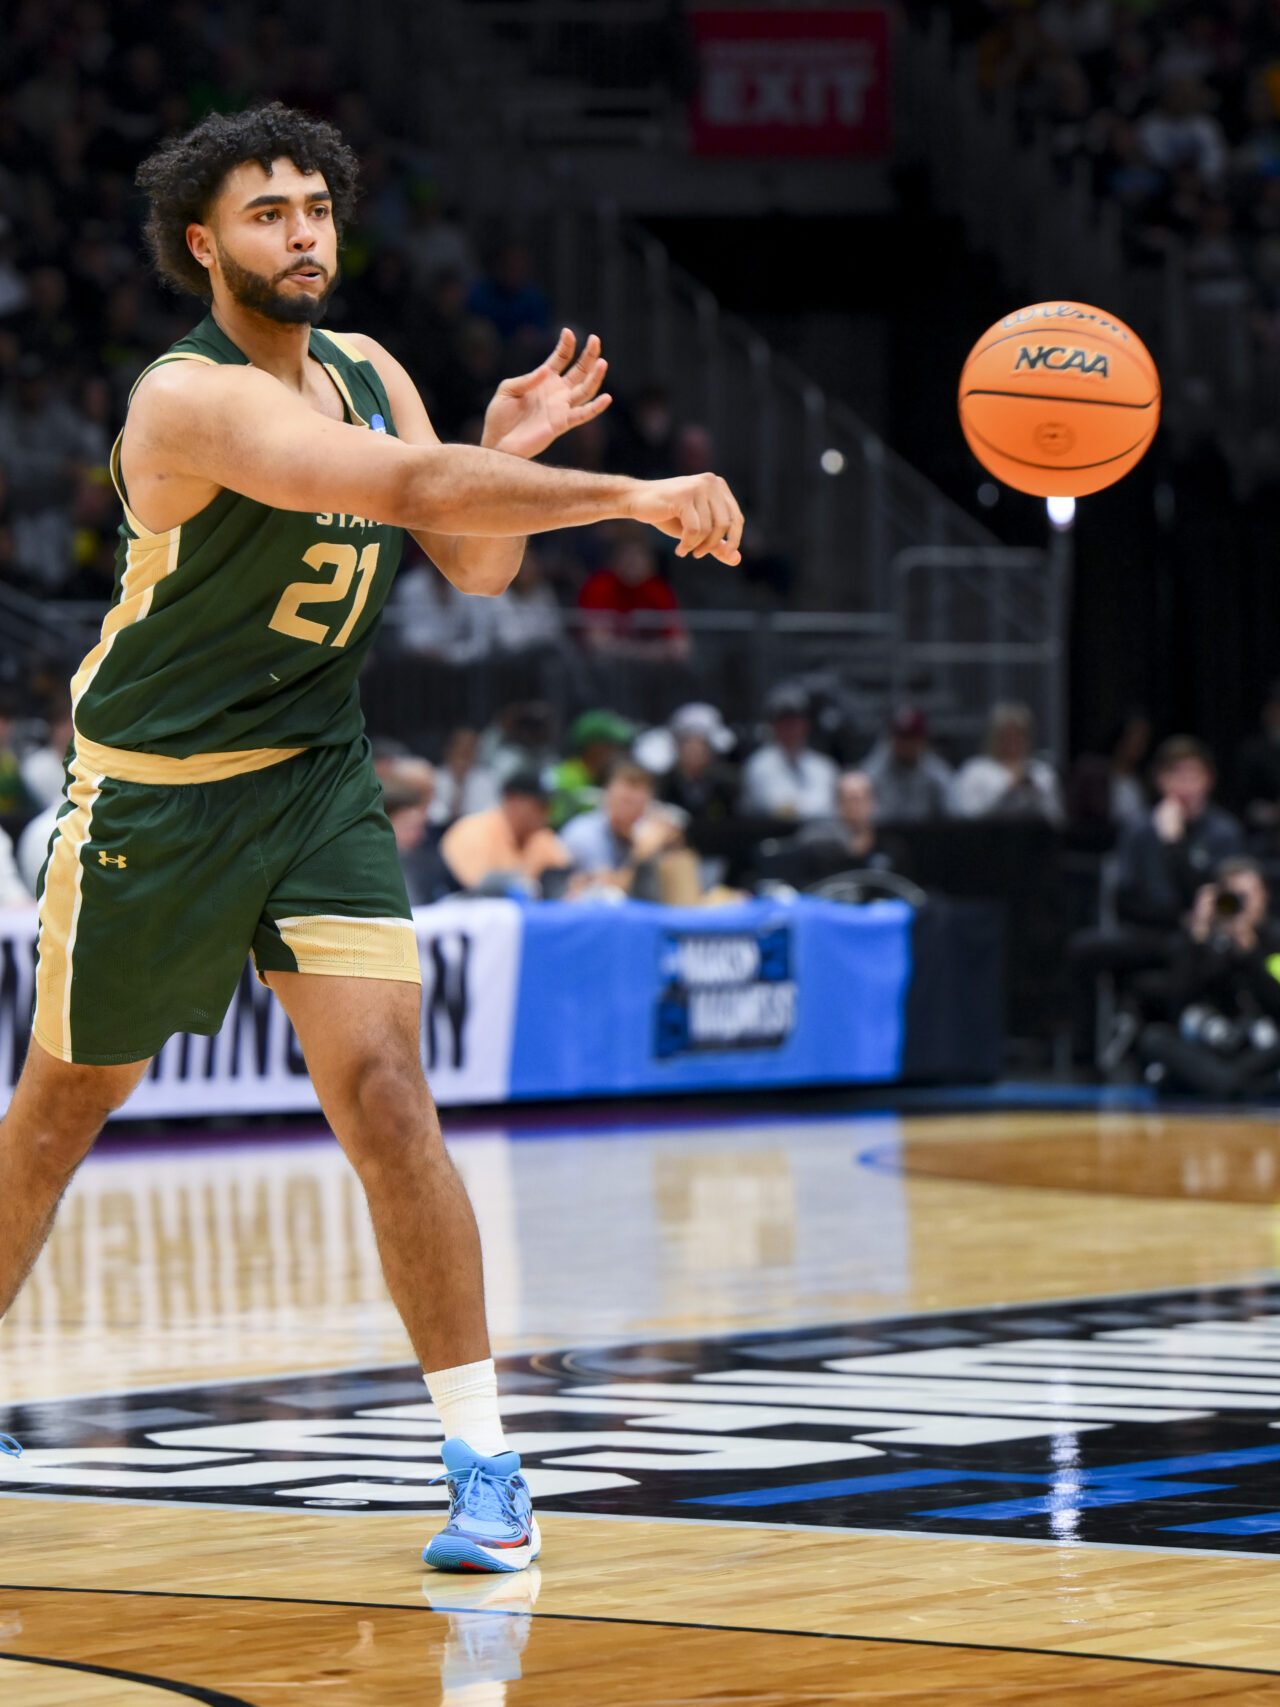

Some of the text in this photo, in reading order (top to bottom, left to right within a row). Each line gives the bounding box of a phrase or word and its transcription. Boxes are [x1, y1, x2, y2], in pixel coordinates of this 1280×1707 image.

[705, 67, 870, 127] EXIT
[1015, 345, 1110, 379] NCAA
[268, 542, 380, 648] 21
